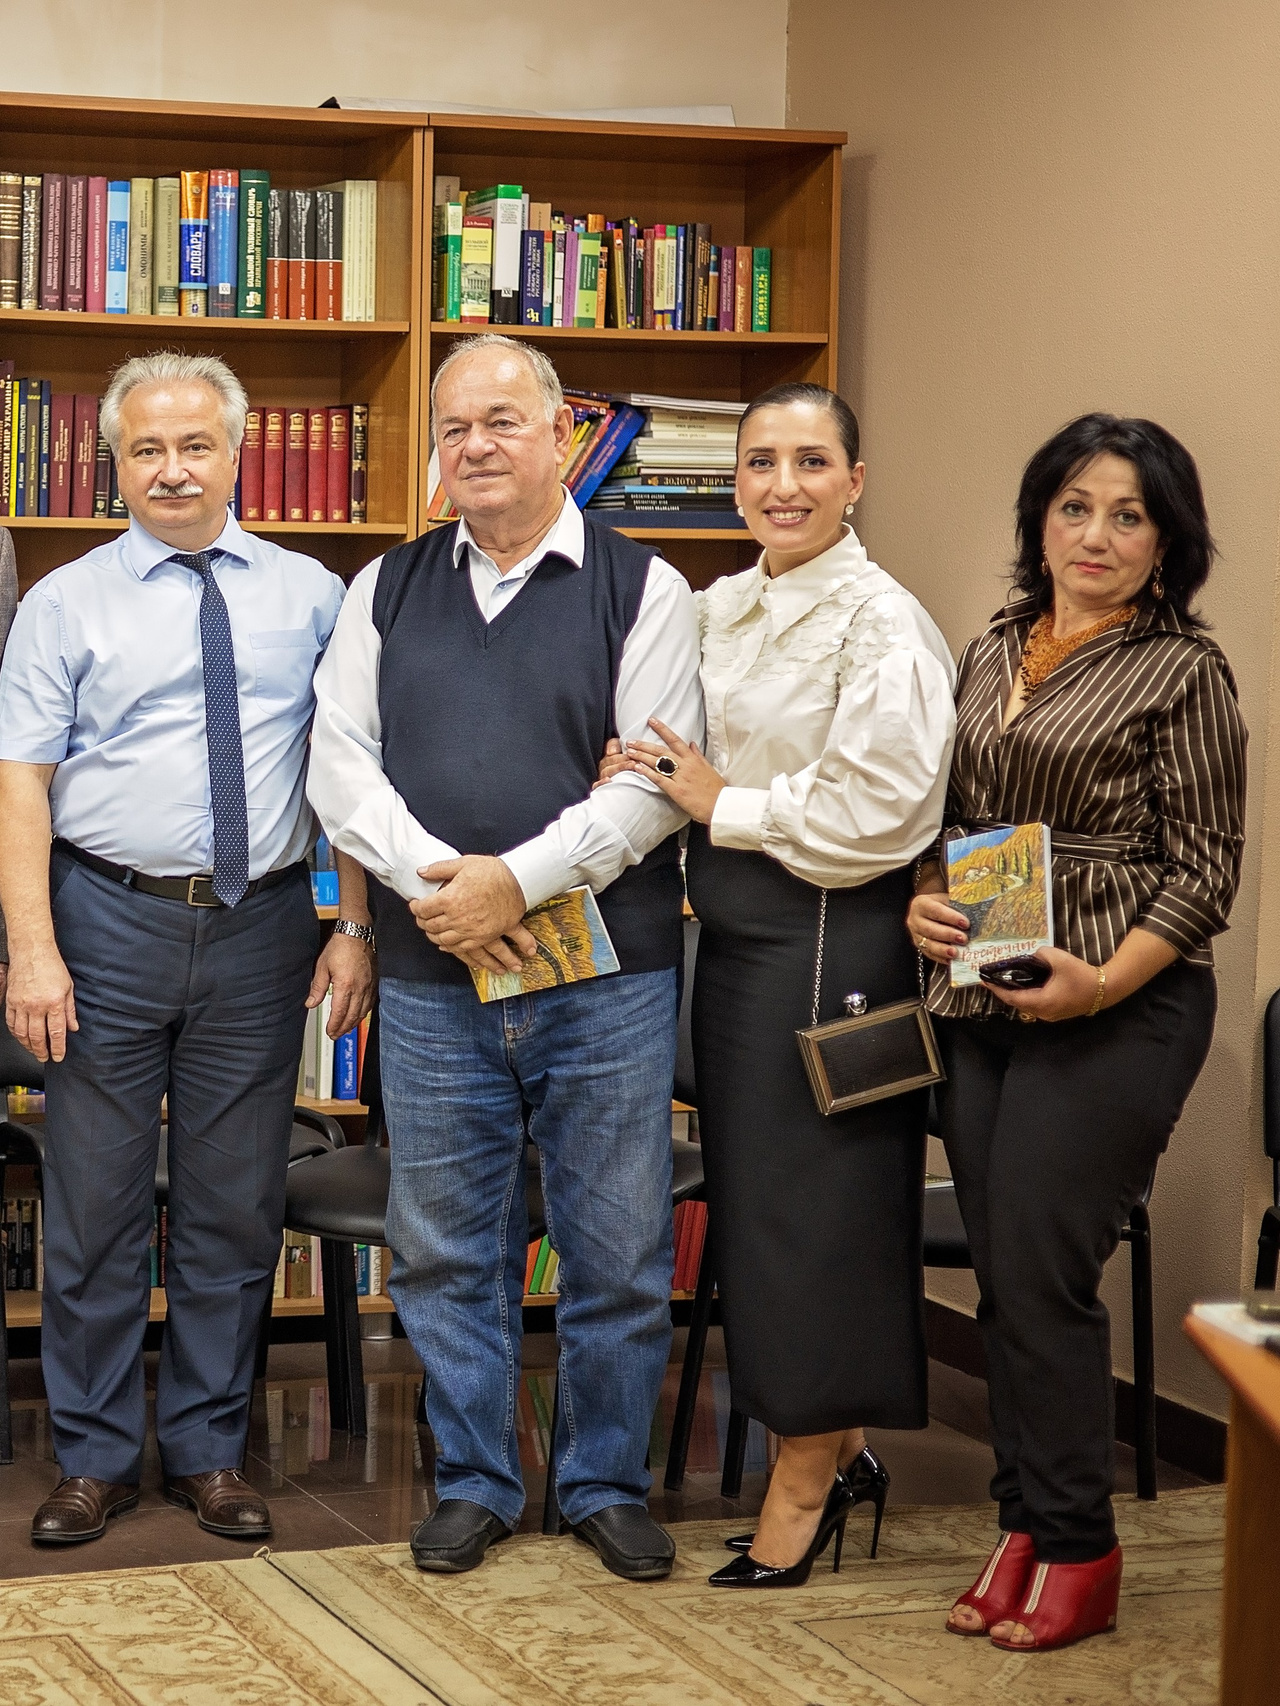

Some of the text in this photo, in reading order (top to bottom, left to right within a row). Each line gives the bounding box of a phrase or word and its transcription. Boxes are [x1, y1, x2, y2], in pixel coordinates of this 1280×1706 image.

[53, 181, 62, 235] ЭНЦИКЛОПЕДИЧЕСКИЙ
[75, 181, 83, 235] ЭНЦИКЛОПЕДИЧЕСКИЙ
[139, 234, 147, 279] ОМОНИМЫ
[190, 231, 202, 276] СЛОВАРЬ
[246, 188, 256, 287] БОЛЬШОЙ ТОЛКОВЫЙ СЛОВАРЬ
[757, 273, 766, 326] СЛОВАРЬ
[4, 381, 12, 427] УКРАИНЫ
[19, 430, 27, 454] КОНТУРЫ
[1, 454, 10, 497] РУССКИЙ
[664, 475, 725, 486] ЗОЛОТО МИРА
[962, 940, 1037, 963] Восточные
